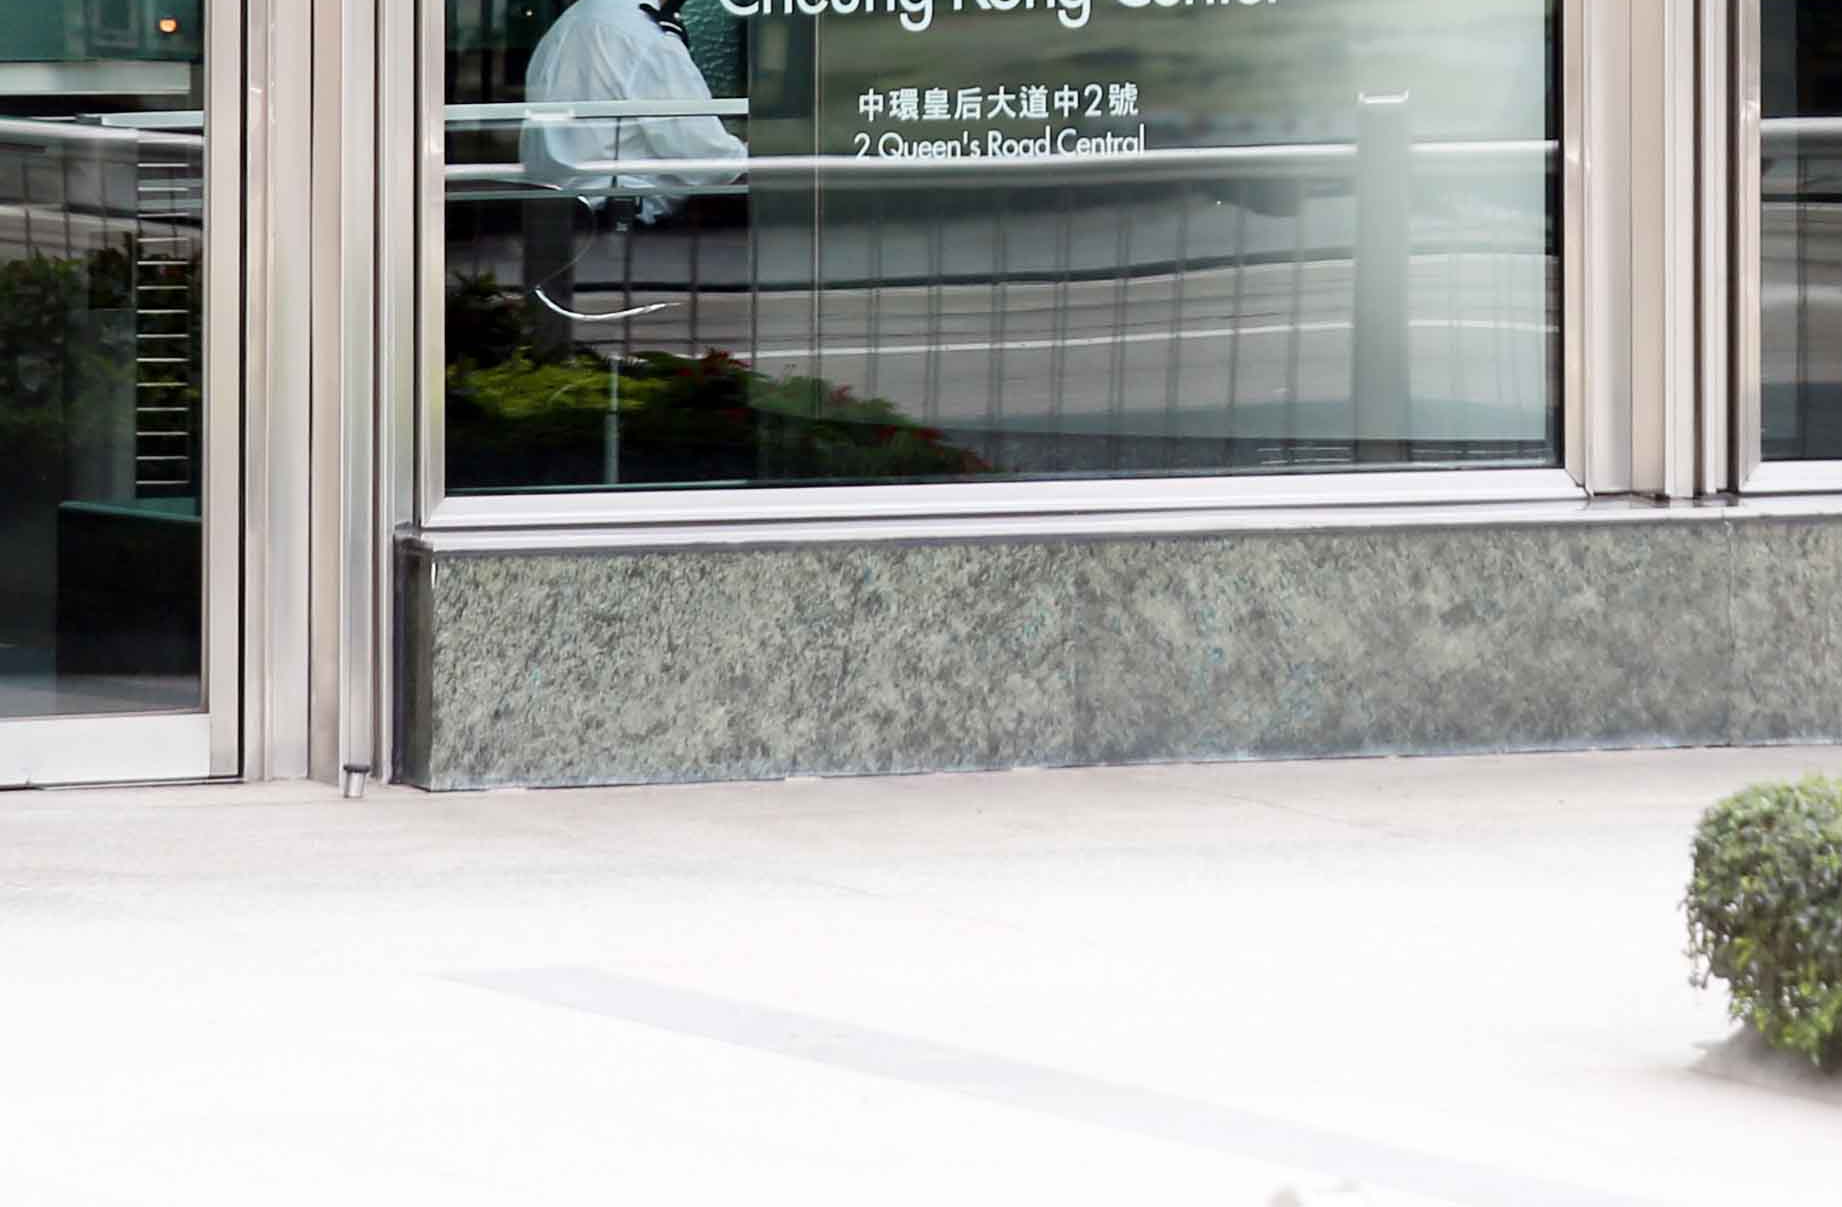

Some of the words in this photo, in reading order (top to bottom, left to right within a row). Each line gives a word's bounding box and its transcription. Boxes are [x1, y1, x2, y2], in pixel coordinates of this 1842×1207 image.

[857, 82, 1140, 123] 中環皇后大道中2號
[853, 132, 872, 161] 2
[877, 129, 981, 161] Queen's
[986, 124, 1051, 159] Road
[1056, 122, 1146, 157] Central
